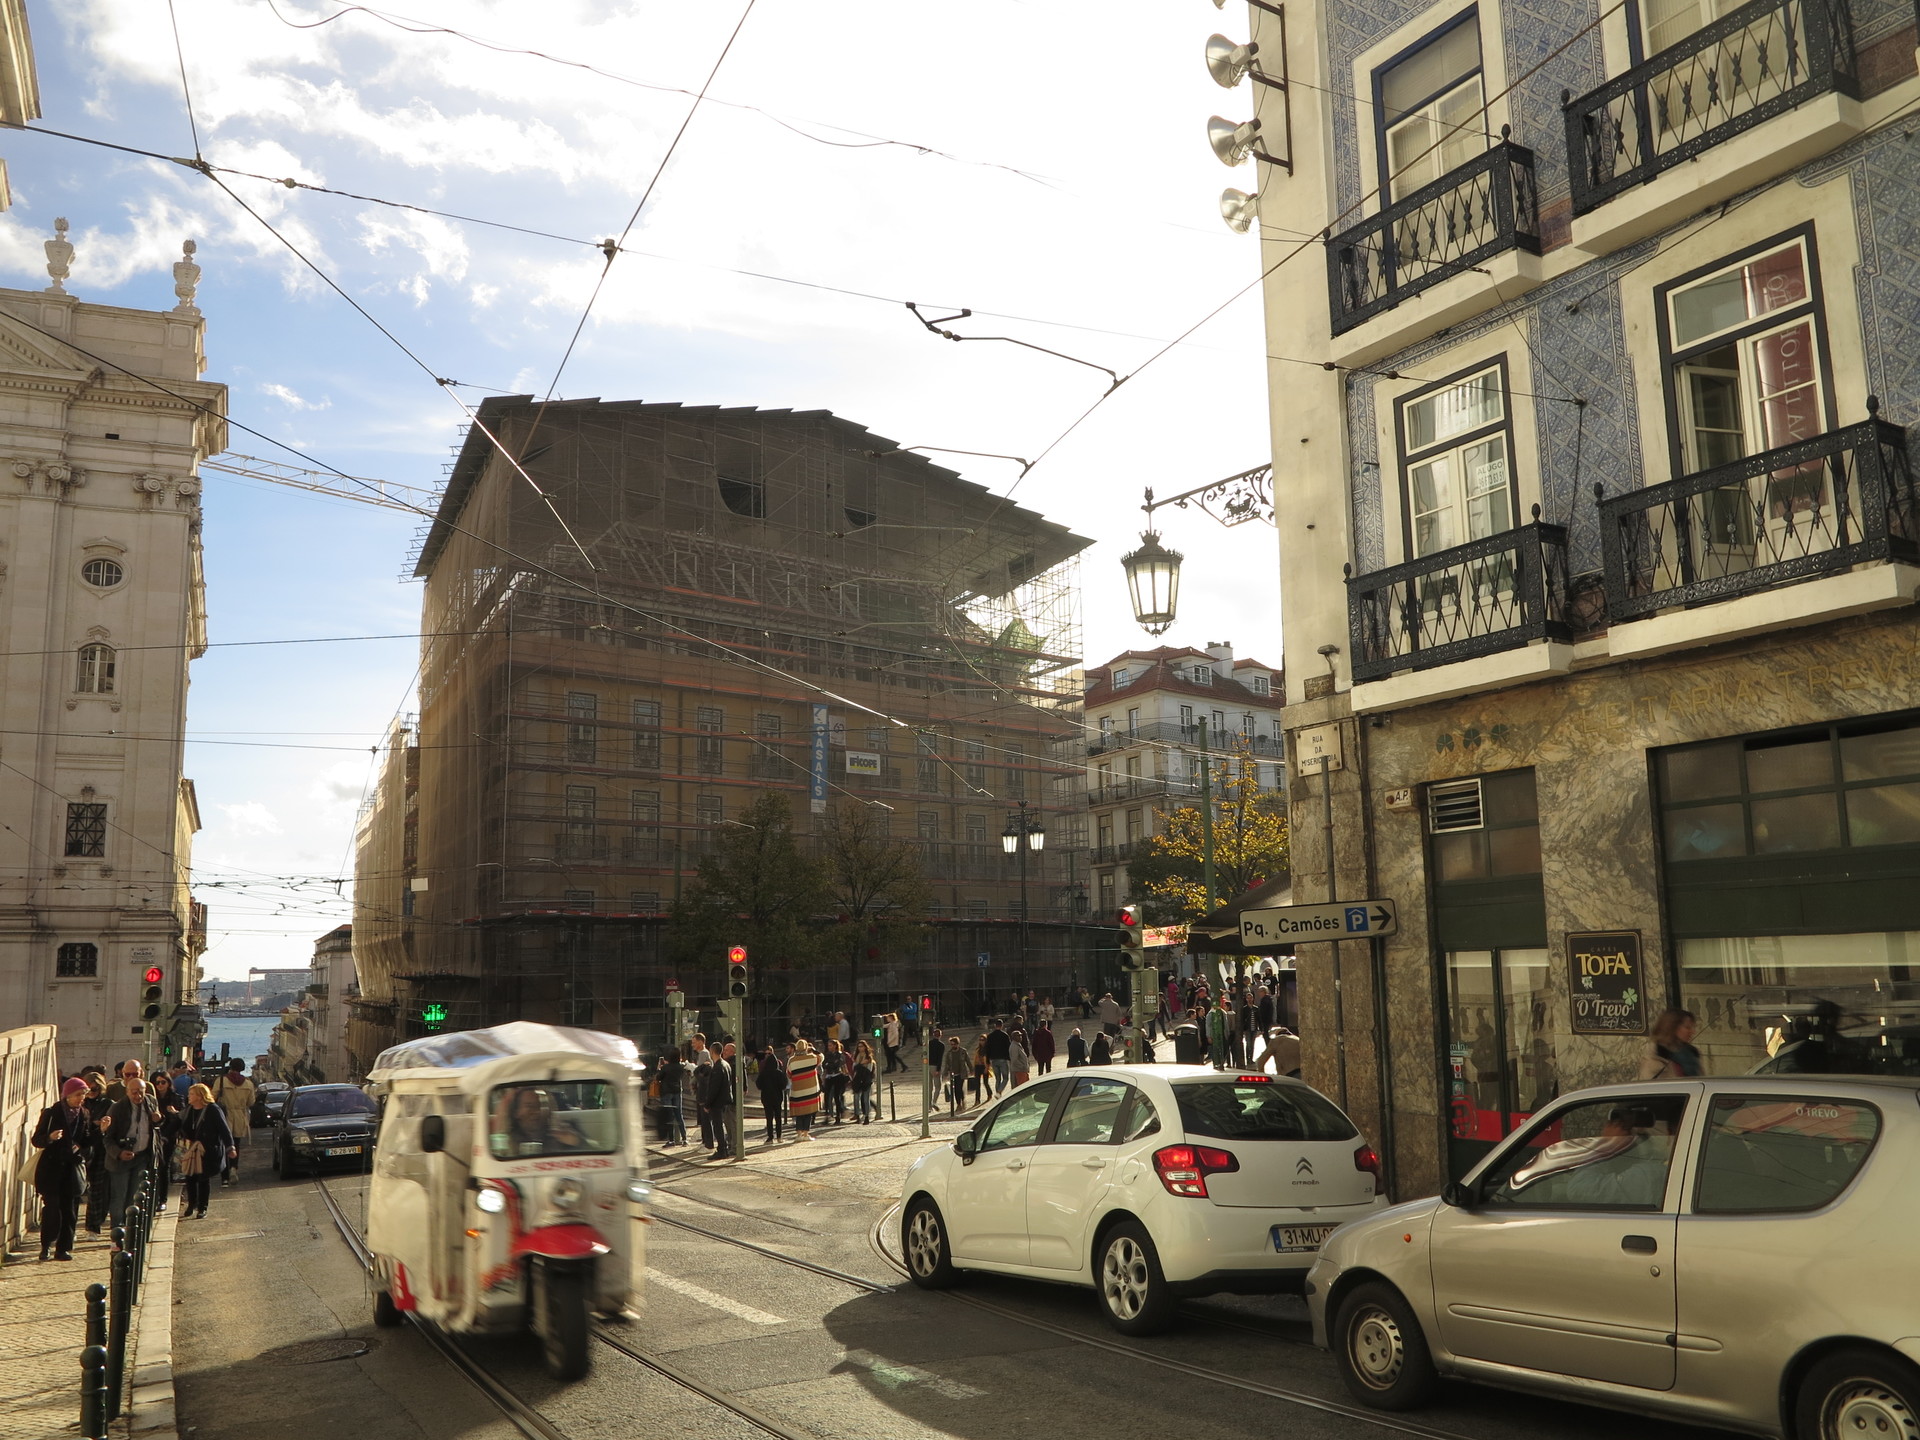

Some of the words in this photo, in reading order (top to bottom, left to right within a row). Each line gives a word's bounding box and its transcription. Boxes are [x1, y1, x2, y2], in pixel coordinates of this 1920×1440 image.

[1478, 461, 1503, 475] ALUGO
[1581, 678, 1752, 734] LEITARIA
[1312, 735, 1324, 744] RUA
[1314, 746, 1323, 754] DA
[1243, 921, 1268, 938] Pq.
[1278, 916, 1340, 934] Camões
[1575, 952, 1632, 976] TOFA
[1576, 1000, 1589, 1017] O
[1591, 1000, 1632, 1017] Trevo
[1795, 1106, 1804, 1116] O
[1806, 1107, 1839, 1119] TREVO
